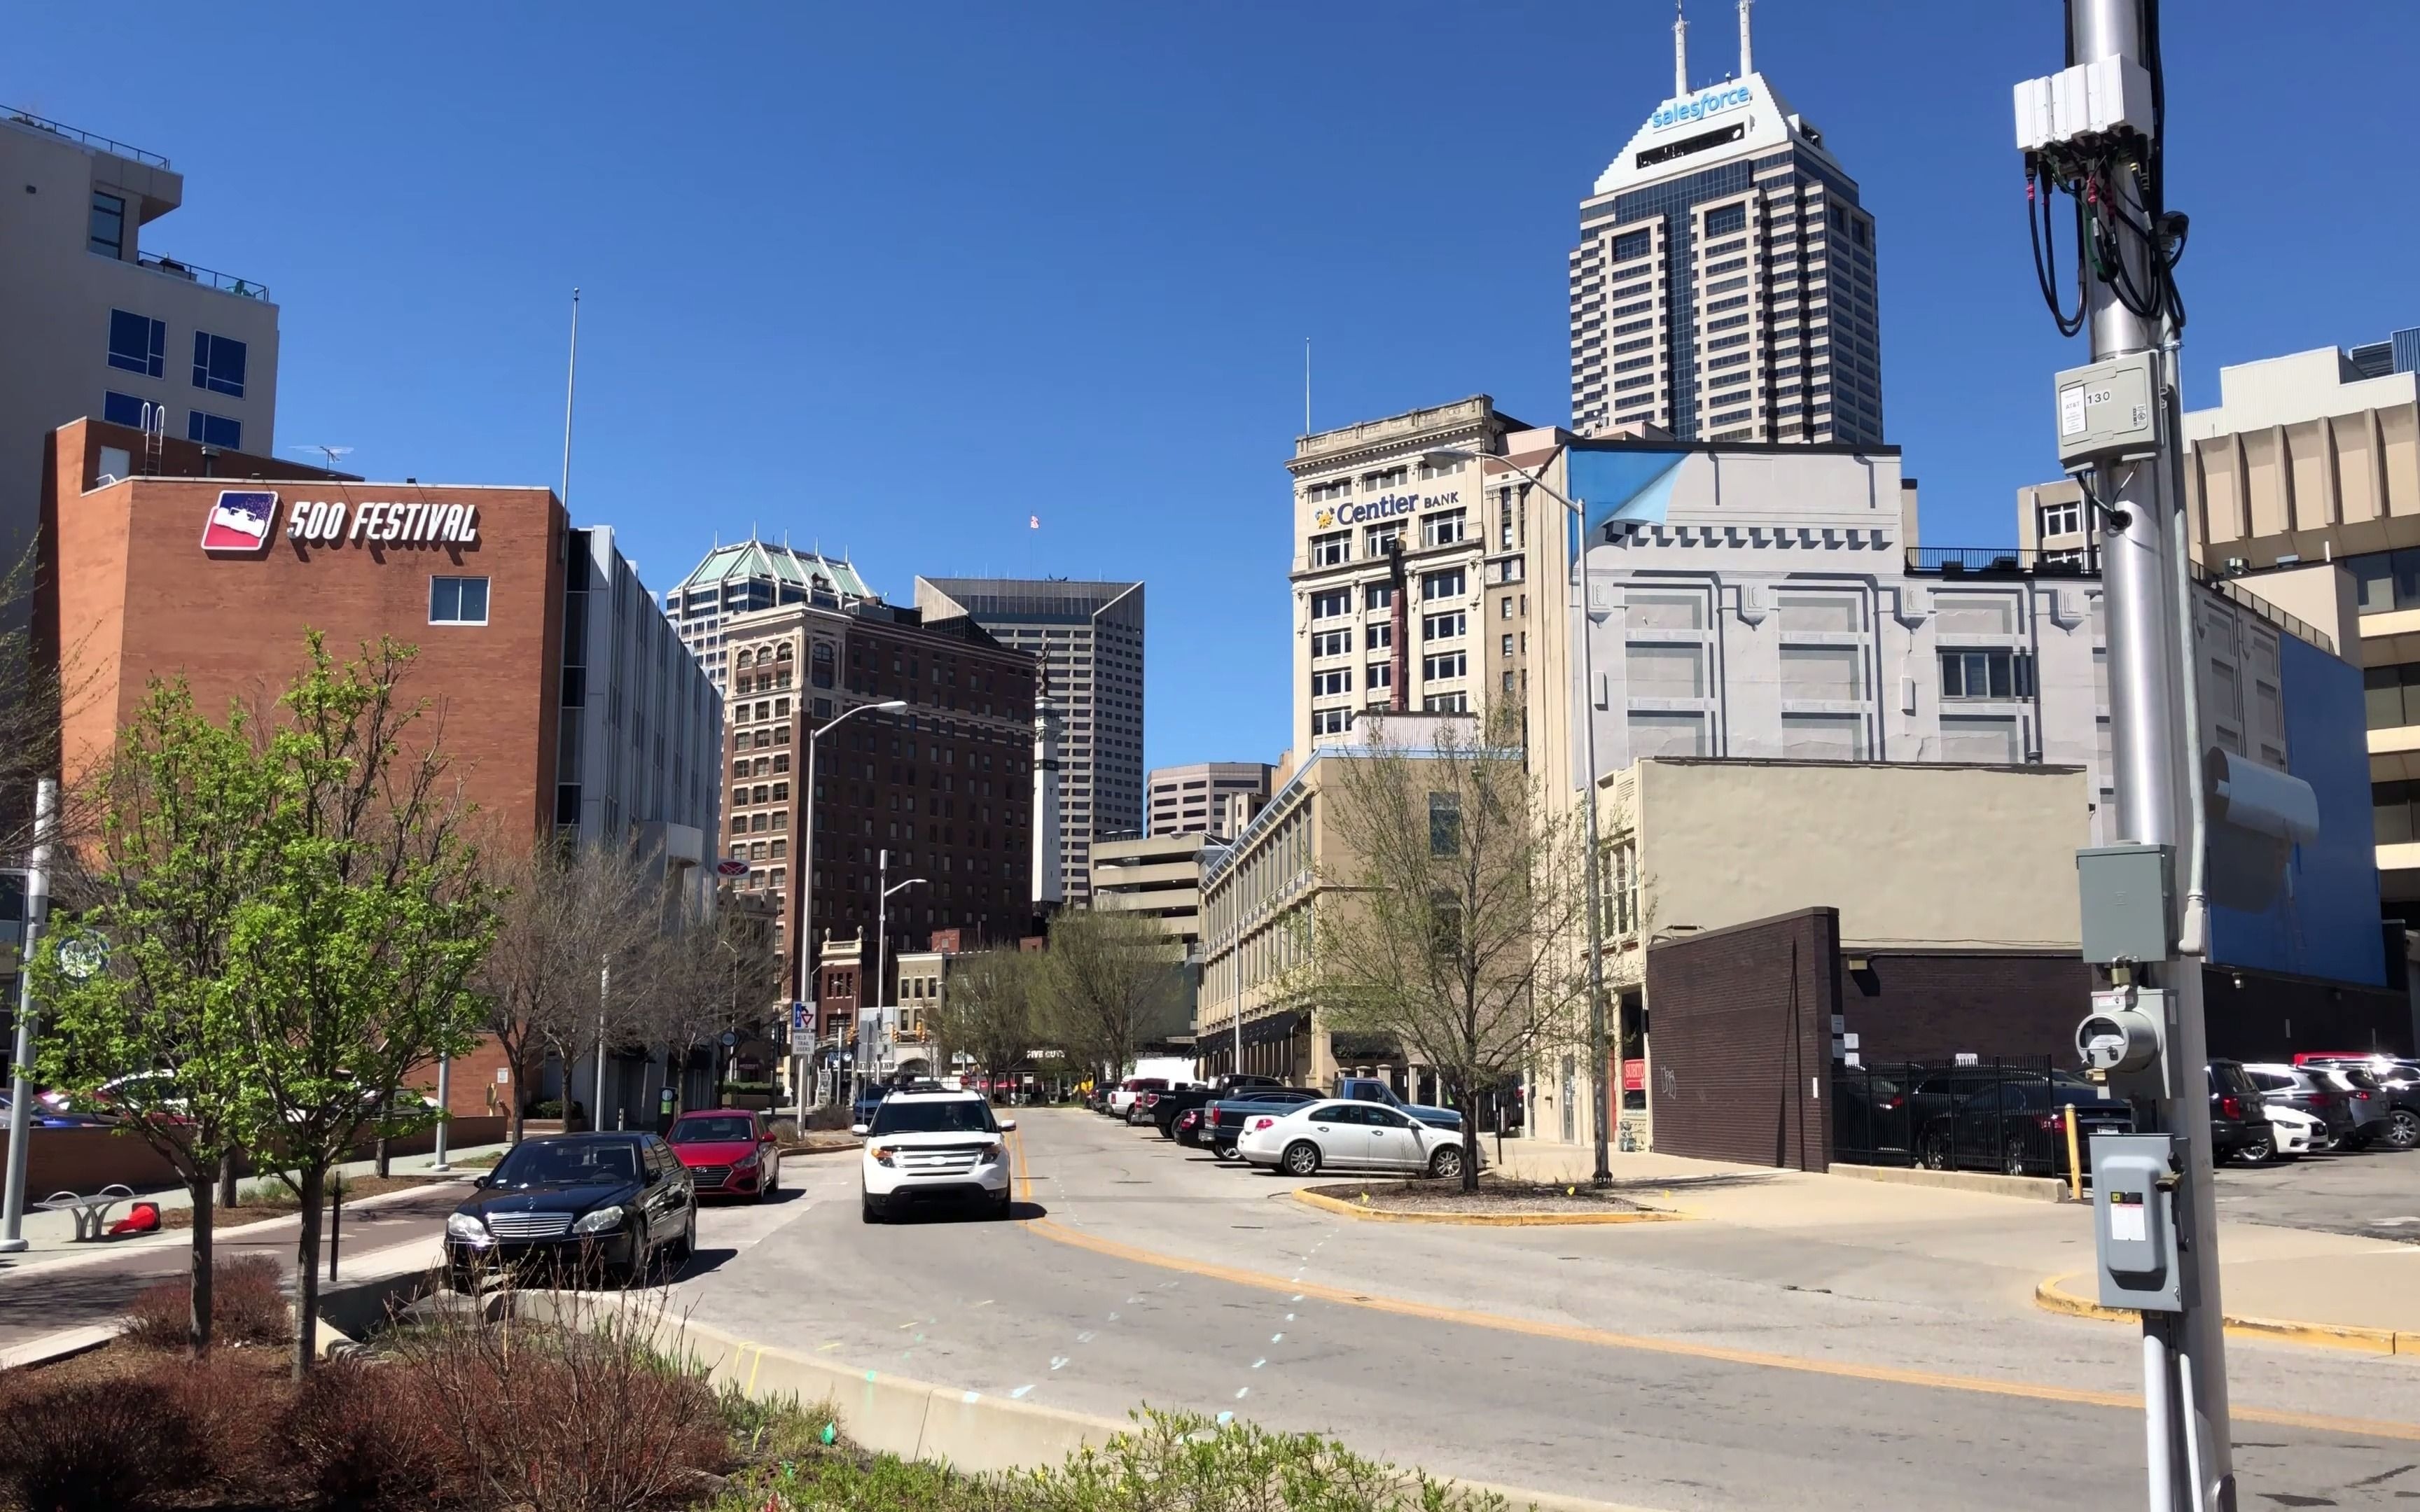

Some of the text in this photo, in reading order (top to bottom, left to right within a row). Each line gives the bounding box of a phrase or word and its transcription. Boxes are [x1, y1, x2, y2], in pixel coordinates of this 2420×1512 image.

[1652, 85, 1750, 128] salesforce
[2087, 391, 2110, 404] 130
[287, 501, 478, 542] 500 FESTIVAL
[1337, 491, 1459, 525] Centier BANK
[1027, 1050, 1043, 1058] FIVE
